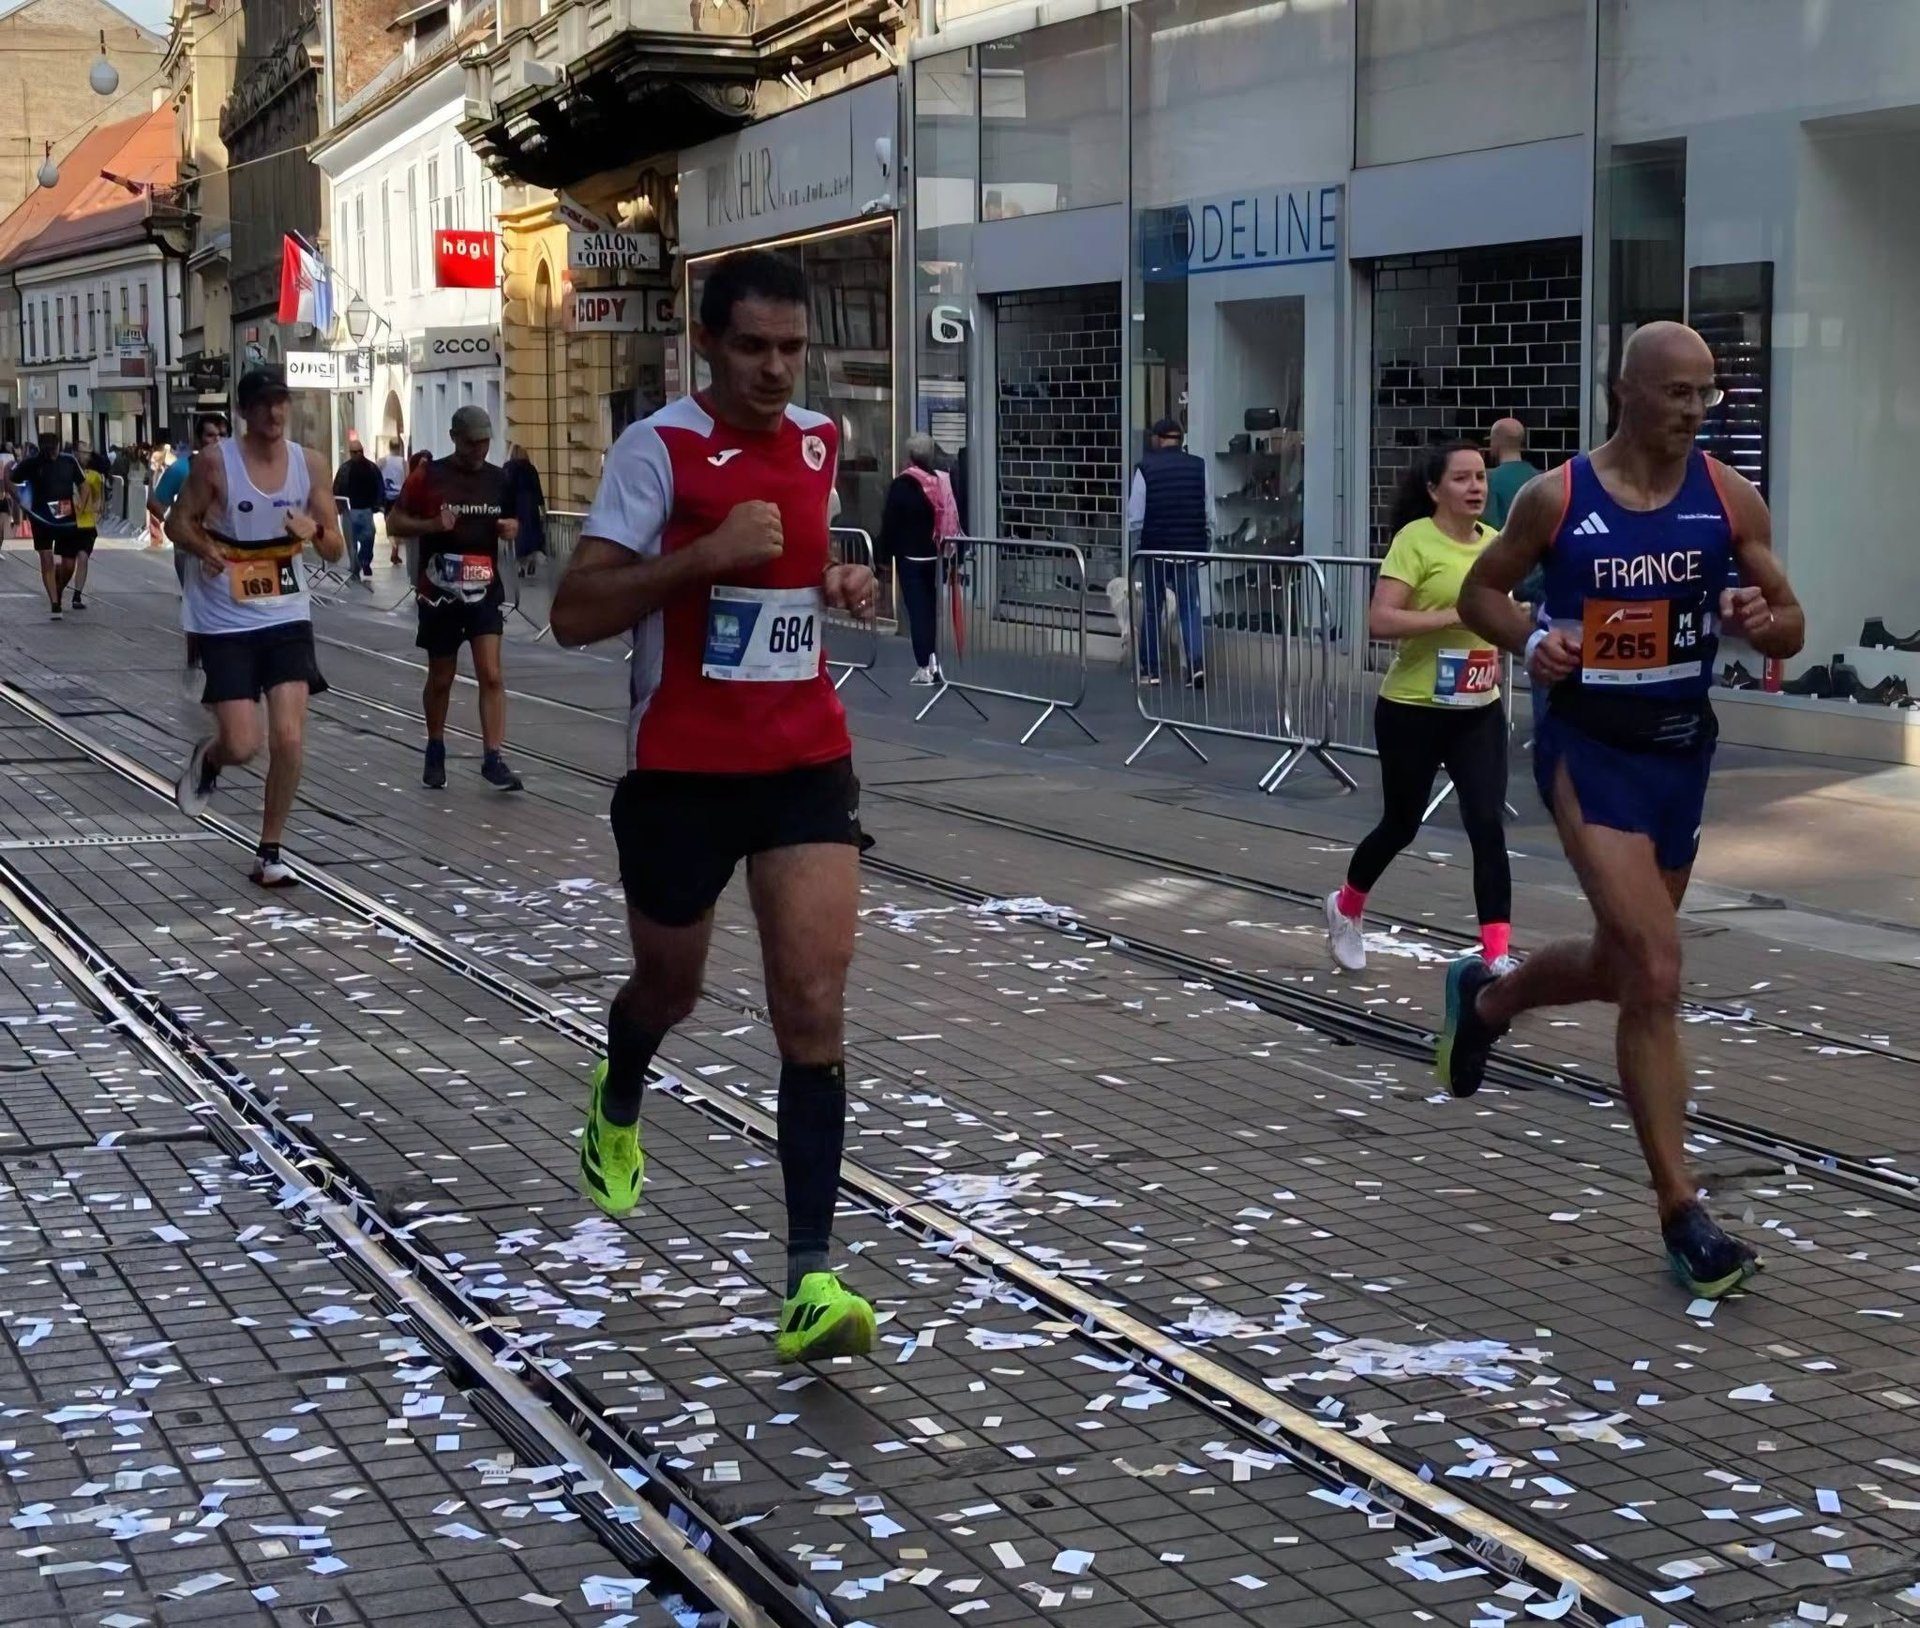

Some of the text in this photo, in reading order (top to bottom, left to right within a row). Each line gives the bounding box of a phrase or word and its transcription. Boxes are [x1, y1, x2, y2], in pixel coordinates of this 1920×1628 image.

[442, 237, 490, 260] högl
[583, 233, 638, 252] SALON
[931, 305, 965, 343] 6
[1594, 550, 1703, 589] FRANCE
[769, 614, 814, 653] 684
[1595, 632, 1656, 661] 265
